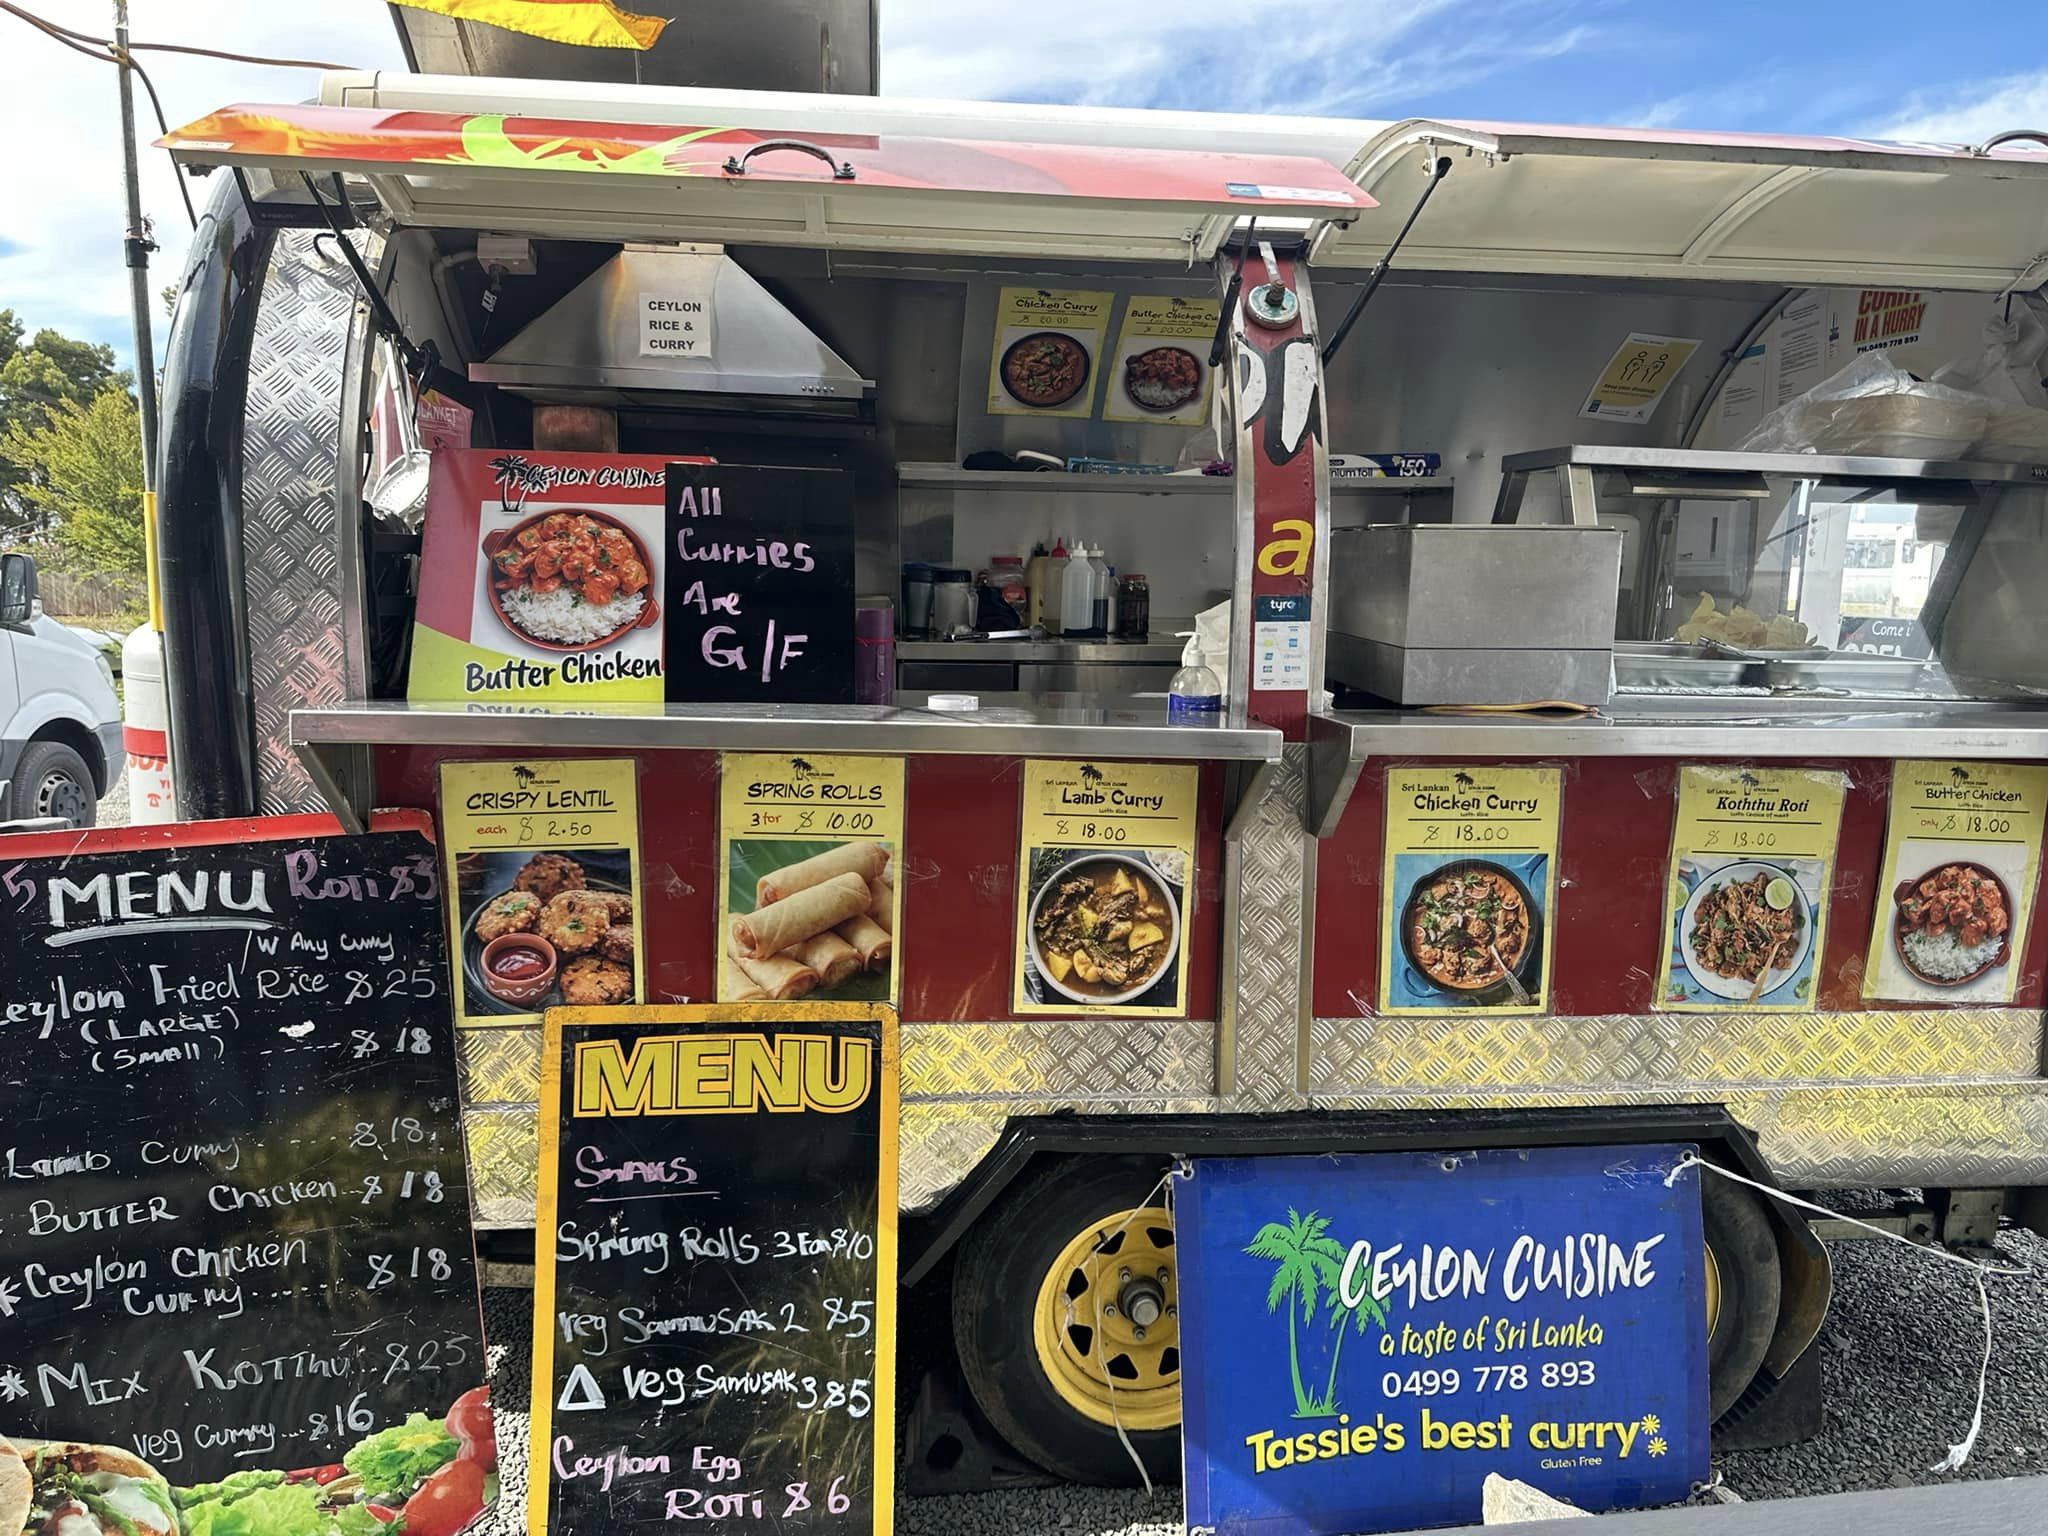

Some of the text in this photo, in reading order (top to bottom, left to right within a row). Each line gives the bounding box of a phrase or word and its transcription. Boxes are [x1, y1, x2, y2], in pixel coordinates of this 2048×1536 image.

[648, 301, 701, 312] CEYLON
[1015, 299, 1060, 310] Chicken
[1063, 301, 1098, 312] Curry
[1131, 310, 1162, 318] Butter
[649, 320, 694, 331] RICE &
[1854, 303, 1926, 343] IN A HURRY
[649, 339, 695, 350] CURRY
[526, 464, 666, 489] CEYLON CUISINE
[1400, 459, 1426, 476] 150
[678, 486, 722, 517] All
[678, 527, 815, 572] Curries
[683, 581, 741, 616] Are
[1270, 600, 1296, 612] tyro
[1872, 621, 1904, 637] Come
[466, 651, 662, 692] Butter Chicken
[747, 783, 882, 800] SPRING ROLLS
[1061, 788, 1163, 810] Lamb Curry
[1402, 784, 1449, 793] Sri Lankan
[1926, 787, 2022, 802] Butter Chicken
[466, 790, 614, 810] CRISPY LENTIL
[1414, 794, 1538, 813] Chicken Curry
[1716, 797, 1809, 812] Koththu Roti
[476, 825, 508, 835] each
[548, 820, 592, 836] 2.50
[750, 812, 761, 827] 3
[763, 811, 782, 825] for
[826, 812, 874, 830] 10.00
[1966, 817, 2010, 833] 18.00
[1082, 823, 1127, 841] 18.00
[1457, 825, 1509, 841] 18.00
[1733, 832, 1776, 847] 18.00
[47, 868, 275, 928] MENU
[291, 931, 329, 960] Any
[149, 962, 240, 1006] Fried
[256, 969, 330, 1000] Rice
[573, 1033, 872, 1118] MENU
[5, 1147, 112, 1179] Lamb
[140, 1133, 240, 1171] Curry
[28, 1196, 180, 1236] BUTTER
[207, 1178, 337, 1213] Chicken
[555, 1222, 671, 1275] Spring
[680, 1226, 761, 1264] Rolls
[24, 1254, 148, 1311] Ceylon
[171, 1238, 308, 1279] Chicken
[1338, 1232, 1667, 1311] CEYLON CUISINE
[122, 1284, 244, 1320] Curry
[1379, 1314, 1604, 1360] a taste of Sri Lanka
[1381, 1360, 1597, 1399] 0499 778 893
[1244, 1414, 1407, 1475] Tassie's
[1421, 1408, 1514, 1451] best
[552, 1436, 743, 1493] Ceylon Egg
[1541, 1455, 1602, 1469] Gluten Free
